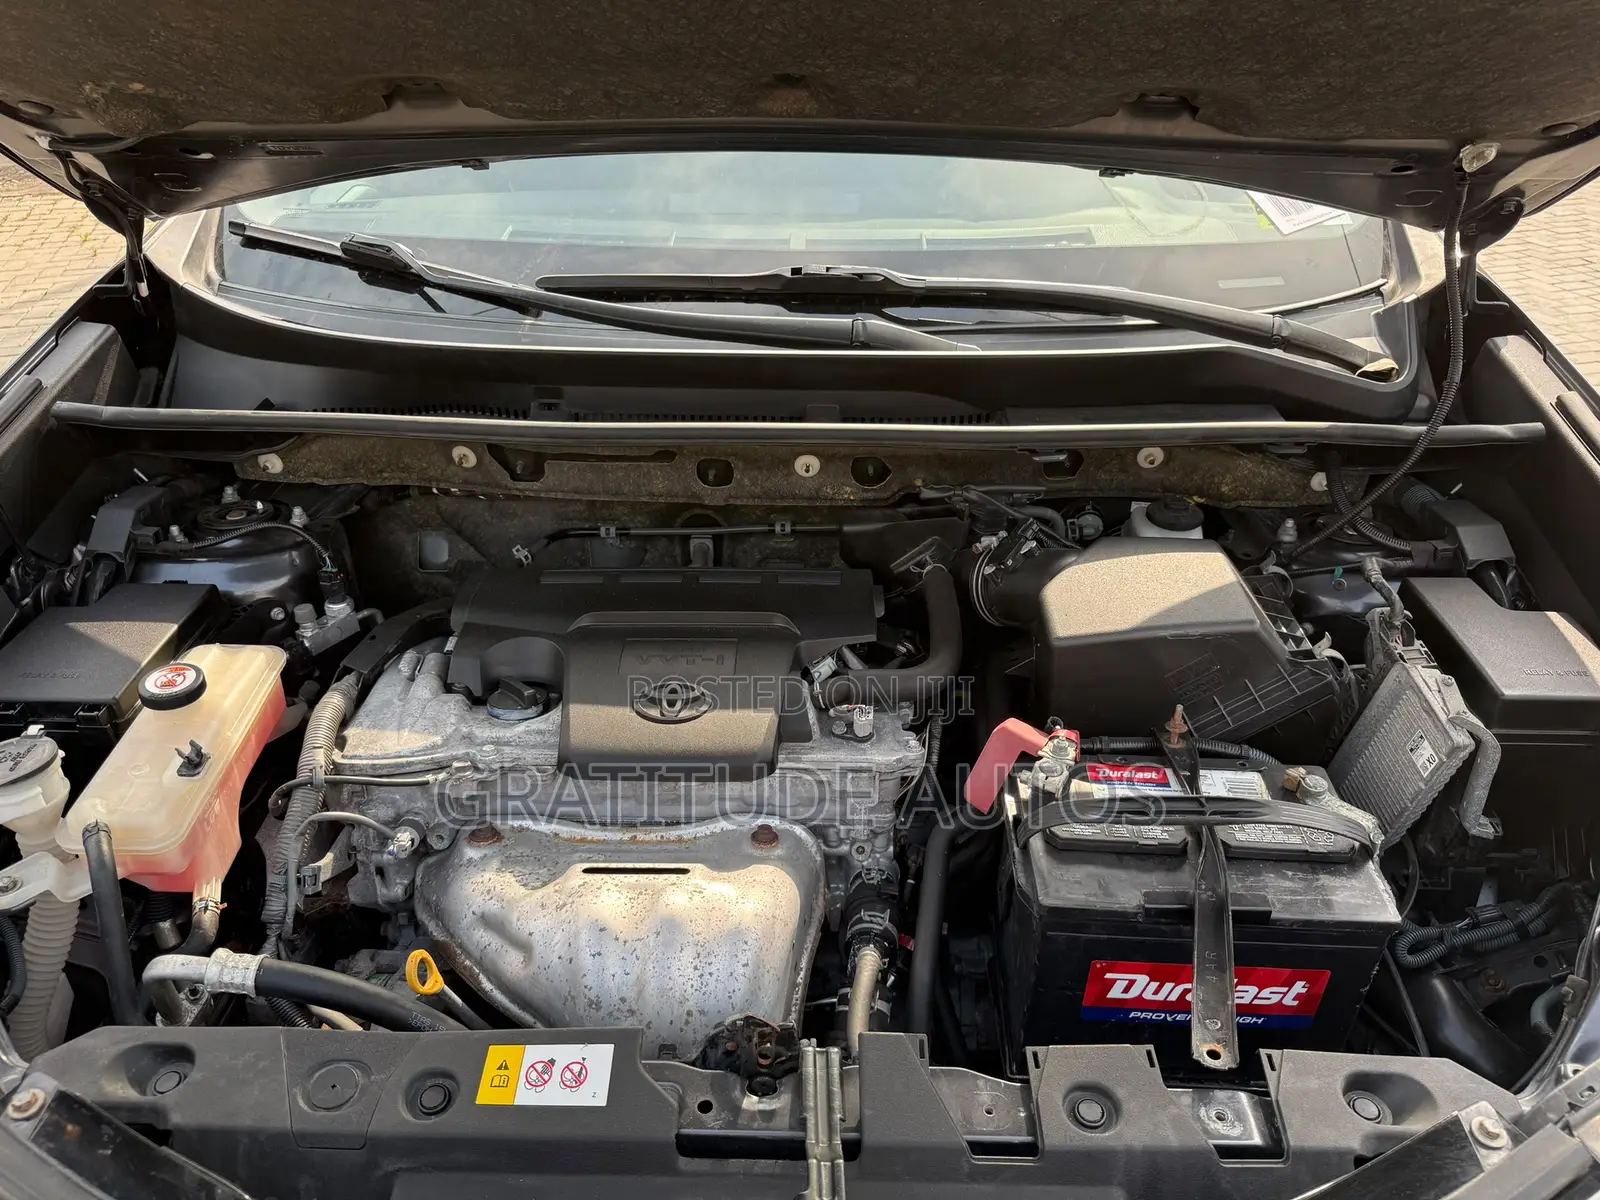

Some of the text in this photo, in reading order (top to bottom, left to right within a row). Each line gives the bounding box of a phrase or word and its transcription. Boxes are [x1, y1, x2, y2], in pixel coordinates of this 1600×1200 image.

[1523, 668, 1554, 676] RELAY
[1095, 768, 1158, 779] Duralast
[1104, 972, 1309, 1006] Durast
